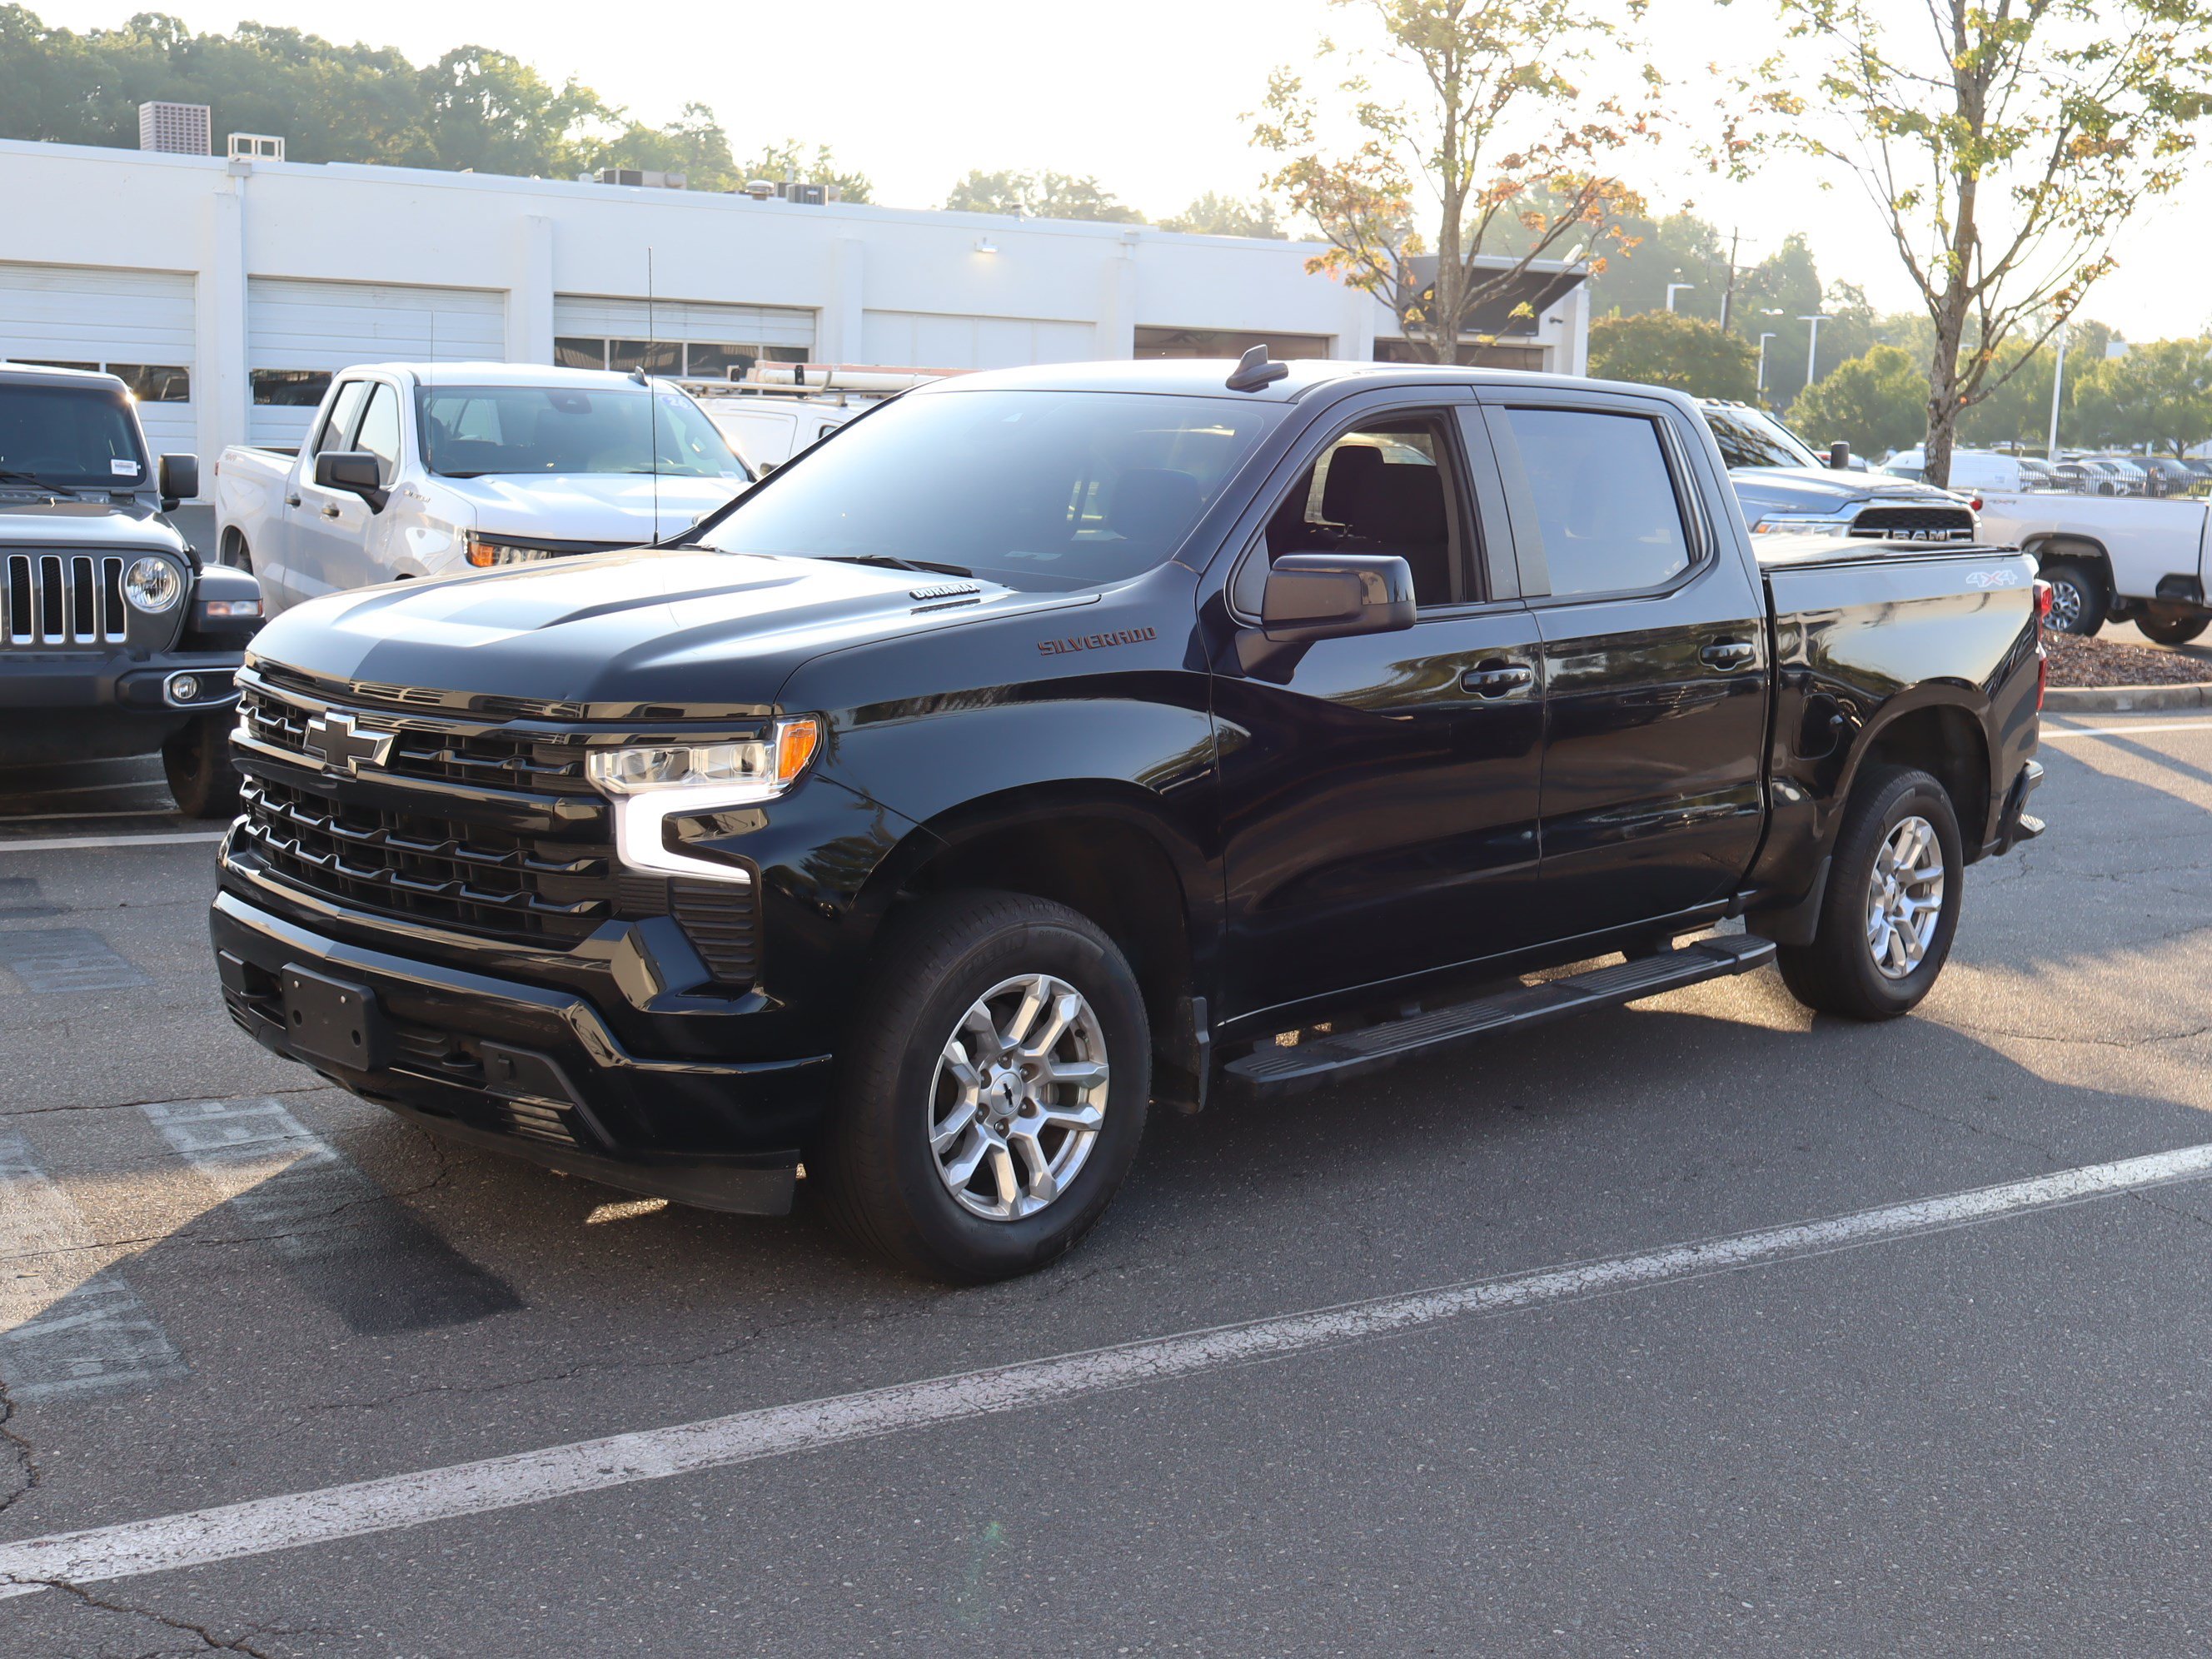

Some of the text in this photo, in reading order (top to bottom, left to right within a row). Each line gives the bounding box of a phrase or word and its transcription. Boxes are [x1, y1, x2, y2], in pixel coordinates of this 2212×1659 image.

[1893, 529, 1946, 541] RAM
[909, 582, 980, 600] DURAMAX
[1038, 626, 1157, 655] SILVERADO
